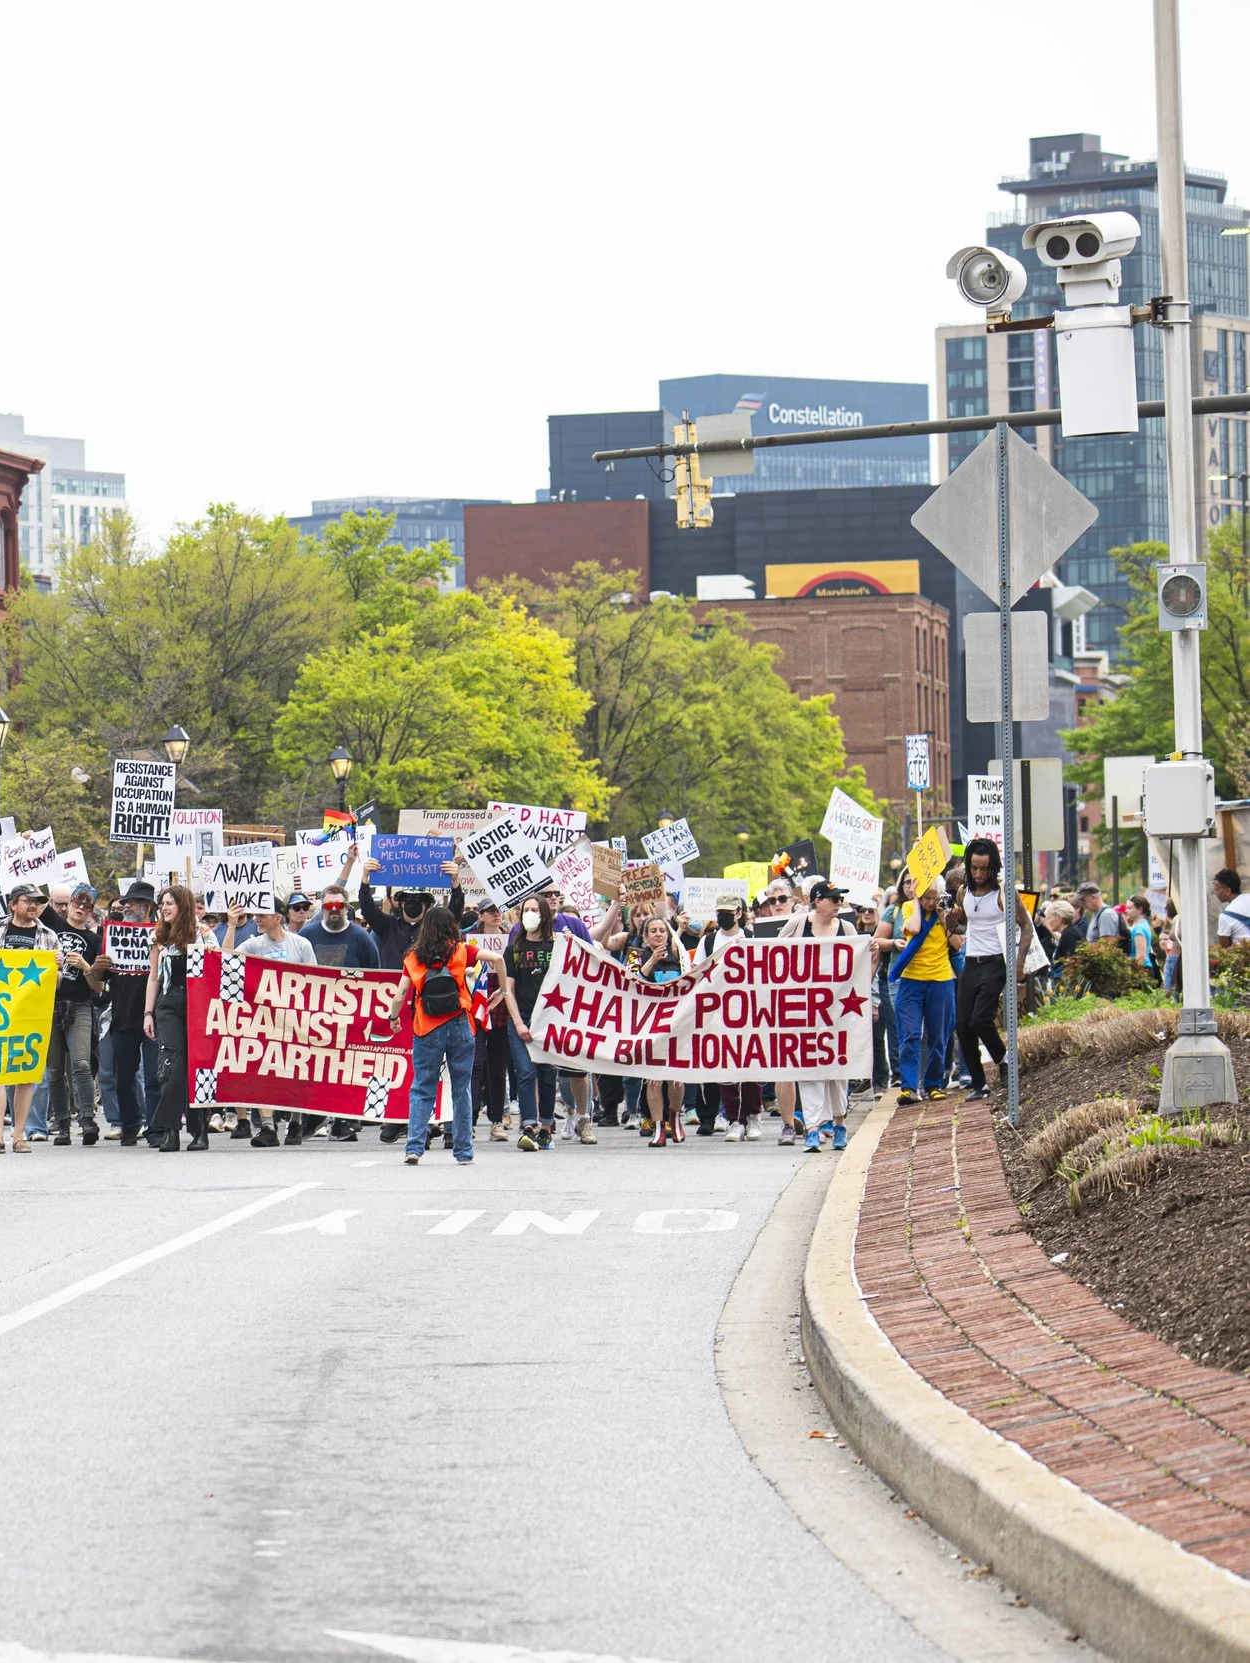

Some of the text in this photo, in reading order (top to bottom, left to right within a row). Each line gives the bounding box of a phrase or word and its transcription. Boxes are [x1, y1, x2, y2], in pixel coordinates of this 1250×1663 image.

[1037, 335, 1047, 394] AVALON
[768, 403, 863, 426] Constellation
[116, 762, 174, 777] RESISTANCE
[124, 775, 165, 789] AGAINST
[975, 780, 1003, 791] TRUMP
[114, 787, 173, 801] OCCUPATION
[980, 794, 1003, 804] MUSK
[115, 801, 171, 816] IS A HUMAN
[422, 810, 450, 820] Trump
[451, 810, 485, 819] crossed
[539, 810, 575, 827] HAT
[835, 811, 862, 828] HANDS
[975, 815, 1001, 825] PUTIN
[114, 813, 170, 837] RIGHT!
[438, 820, 475, 829] Red Line
[643, 822, 683, 845] BRING
[377, 837, 453, 849] GREAT AMERICAN
[467, 819, 517, 860] JUSTICE
[648, 828, 692, 856] KILMAR
[674, 839, 697, 858] ALIVE
[226, 846, 268, 857] RESIST
[381, 850, 447, 860] MELTING POT
[486, 844, 515, 868] FOR
[557, 848, 579, 875] WHAT
[927, 840, 940, 868] STOP
[213, 862, 270, 884] AWAKE
[487, 854, 534, 889] FREDDIE
[916, 842, 934, 885] FASCISM
[503, 873, 534, 898] GRAY
[570, 880, 593, 903] DUE
[224, 891, 271, 910] WOKE
[111, 937, 150, 949] DONA
[115, 949, 151, 961] TRUM
[723, 943, 854, 985] SHOULD
[253, 968, 399, 1020] ARTISTS
[570, 985, 834, 1035] HAVE POWER
[205, 998, 355, 1050] AGAINST
[543, 1023, 848, 1069] NOT BILLIONAIRES!
[214, 1036, 409, 1090] APARTHEID
[257, 1208, 740, 1236] ONLY
